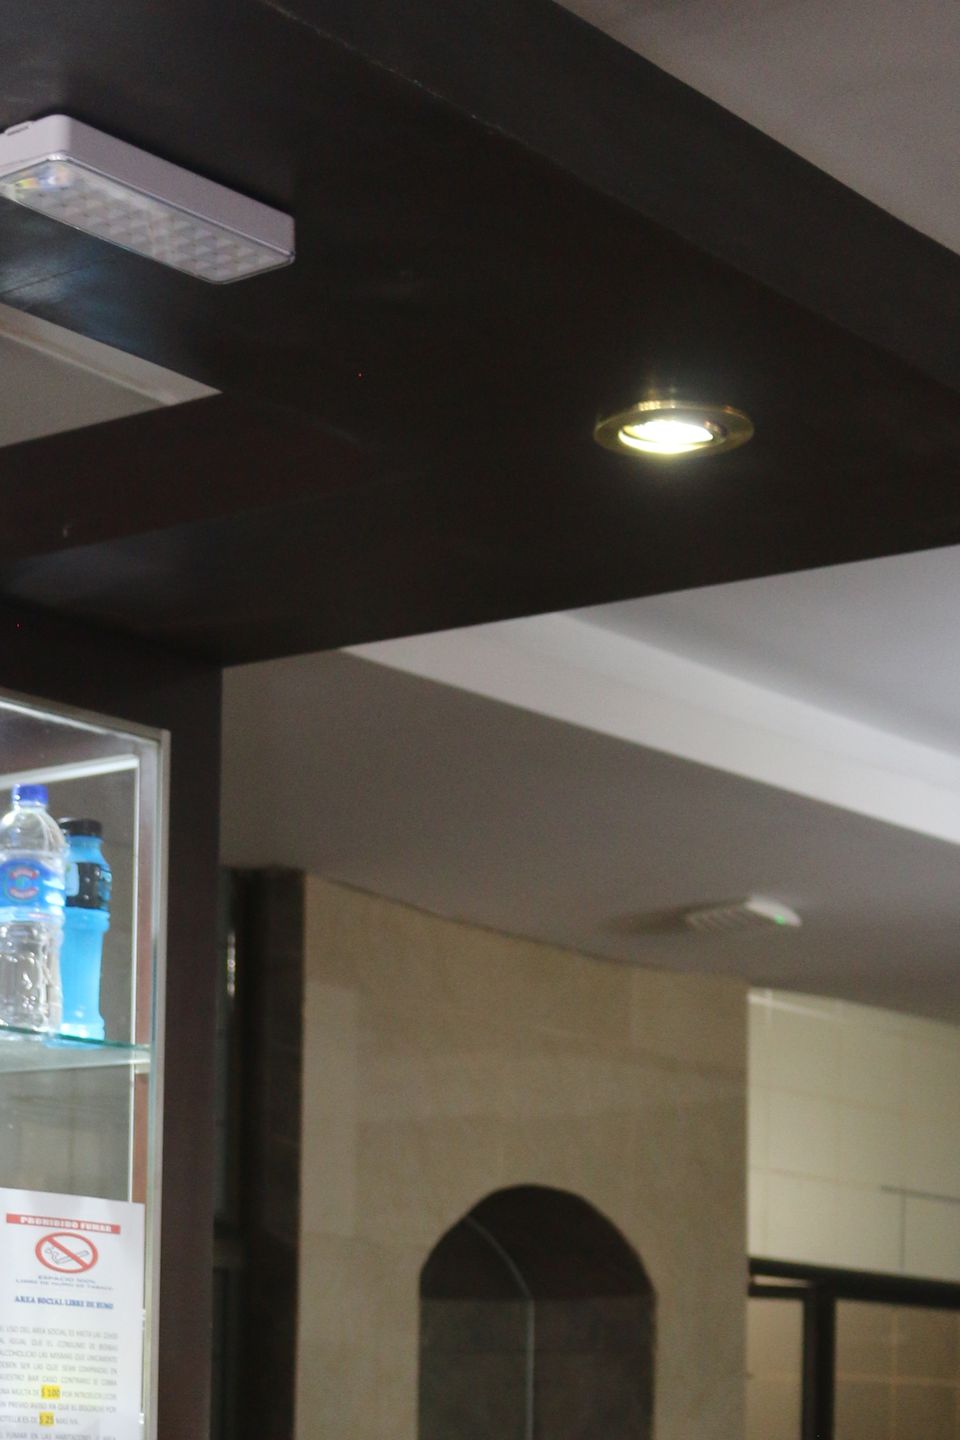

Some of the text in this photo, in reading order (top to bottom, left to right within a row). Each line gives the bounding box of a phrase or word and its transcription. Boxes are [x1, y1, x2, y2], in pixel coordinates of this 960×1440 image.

[20, 1216, 112, 1232] PROHIBIDO FUMAR
[15, 1296, 35, 1304] AREA
[38, 1297, 62, 1306] SOCIAL
[65, 1299, 84, 1307] LIBRE
